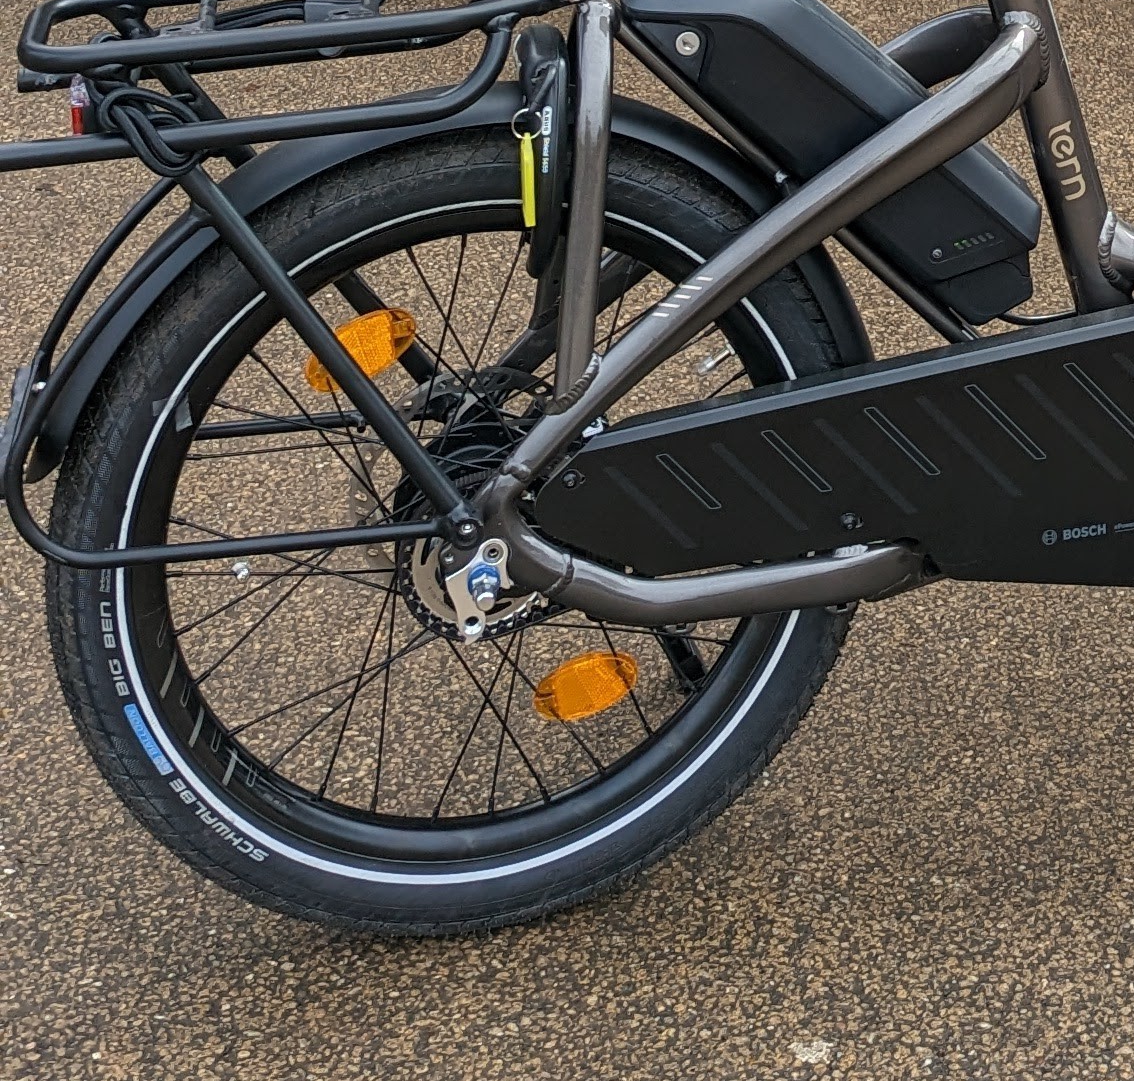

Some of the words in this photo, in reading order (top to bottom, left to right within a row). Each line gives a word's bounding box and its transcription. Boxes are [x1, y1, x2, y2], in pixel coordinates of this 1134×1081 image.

[1048, 120, 1086, 201] tern
[1063, 523, 1107, 540] BOSCH
[100, 601, 116, 649] BEN
[108, 658, 131, 697] BIG
[169, 777, 269, 863] SCHWALBE
